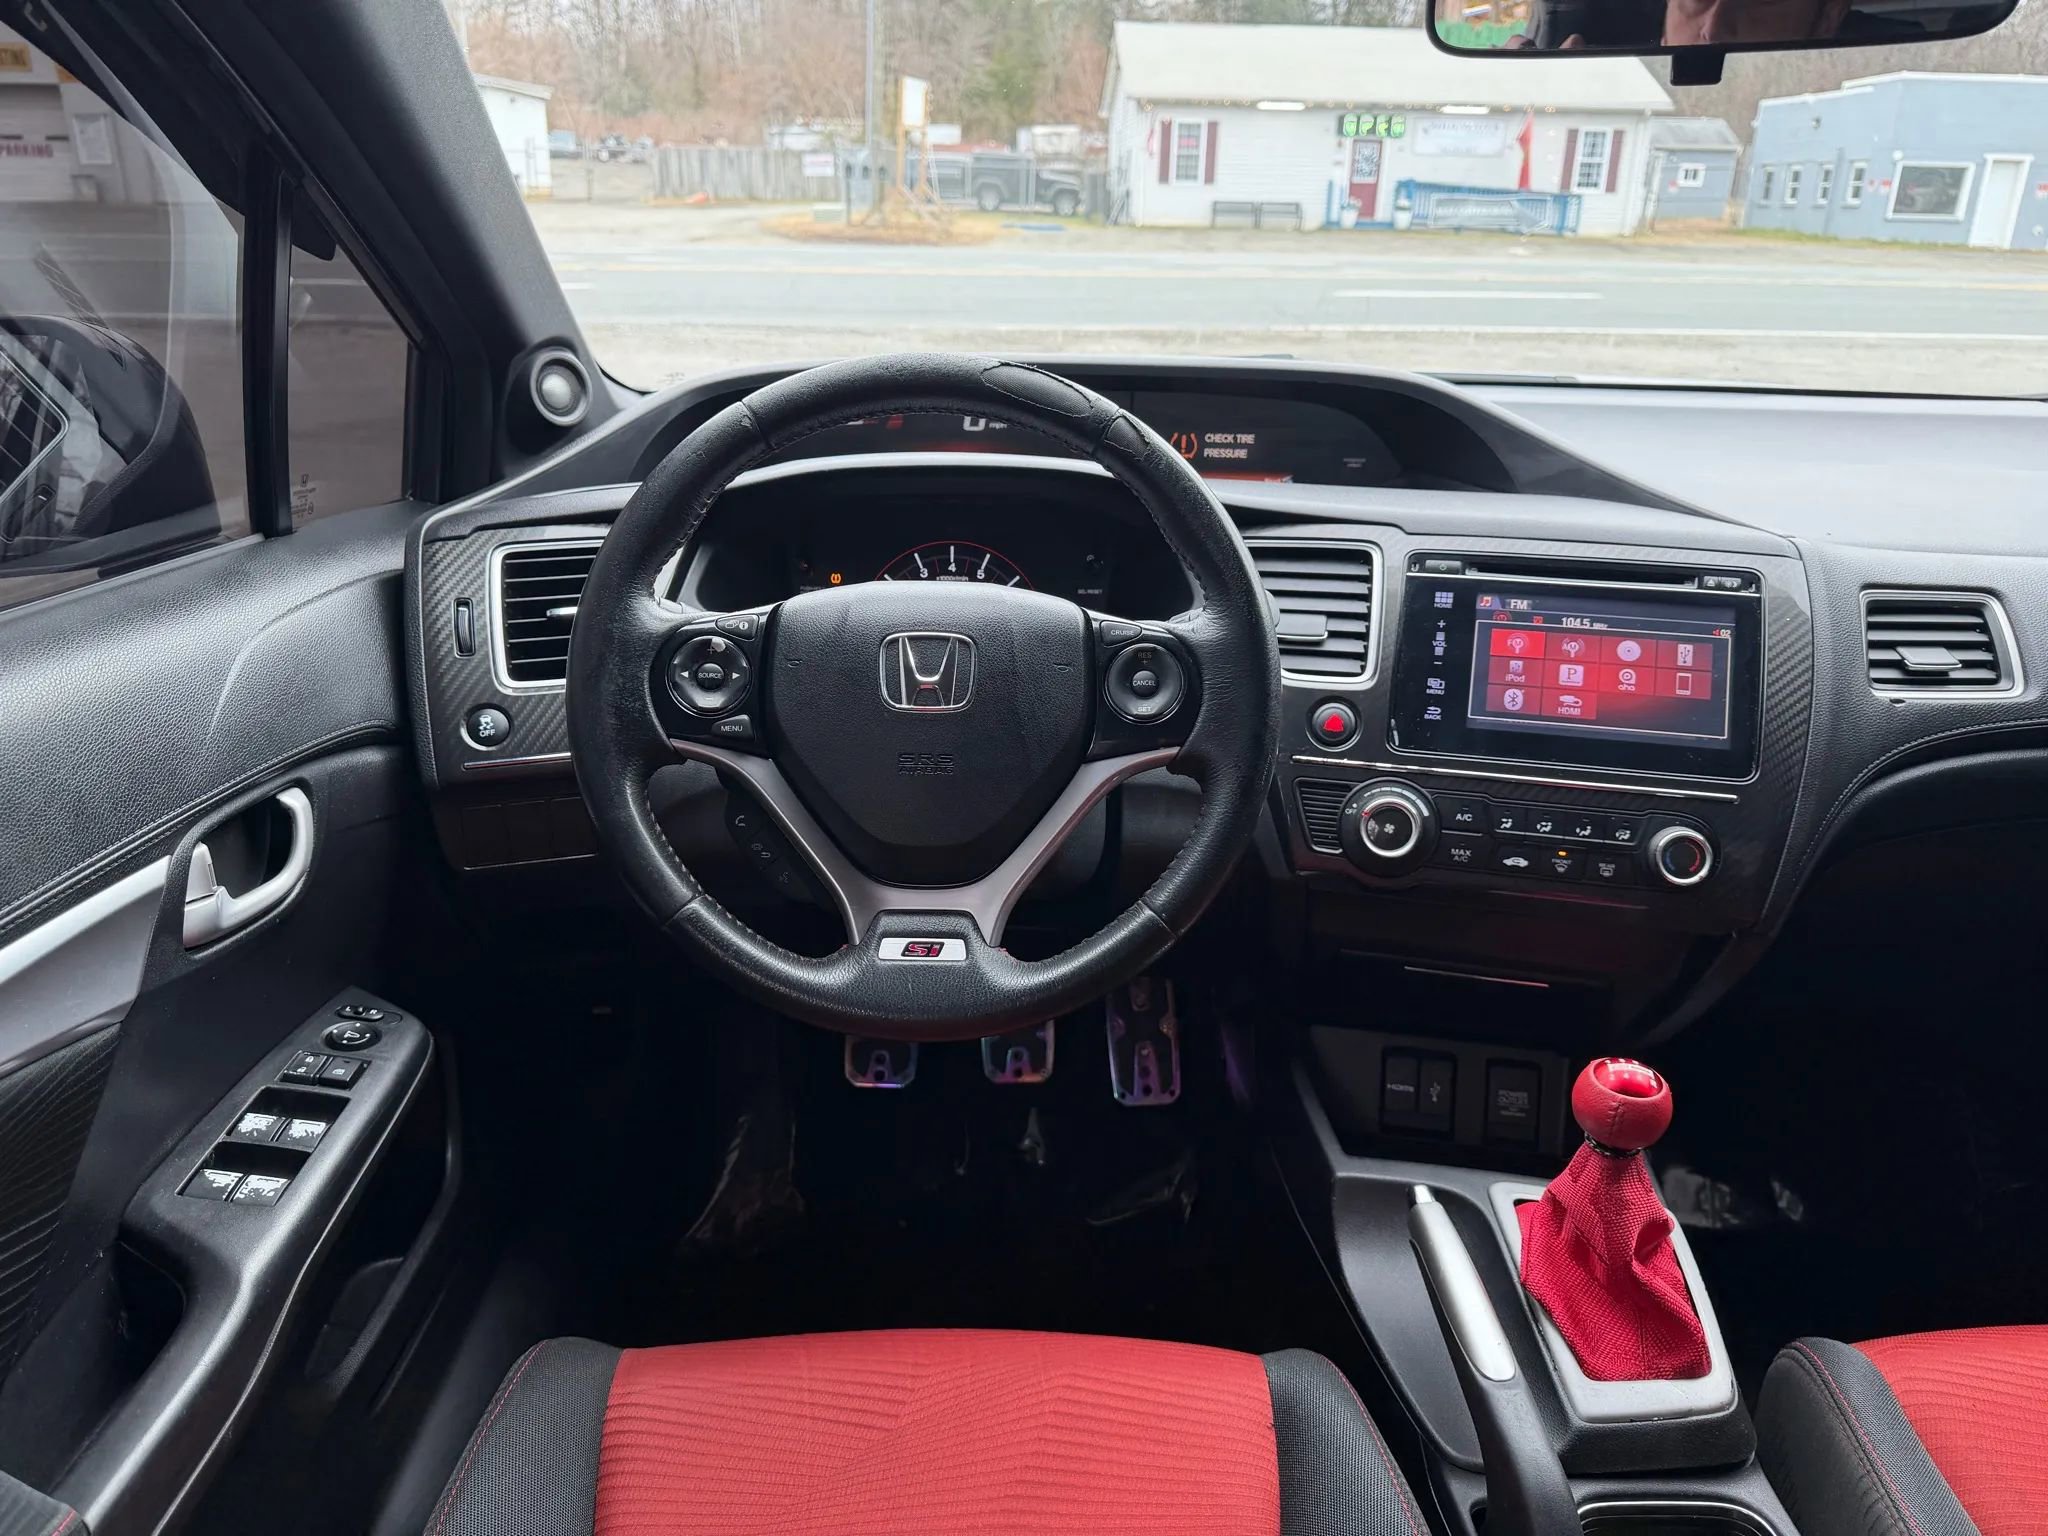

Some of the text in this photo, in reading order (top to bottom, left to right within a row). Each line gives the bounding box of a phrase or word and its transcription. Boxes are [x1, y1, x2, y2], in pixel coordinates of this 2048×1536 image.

[1204, 433, 1255, 445] CHECK TIRE
[1203, 448, 1249, 459] PRESSURE
[919, 567, 929, 578] 3
[948, 562, 957, 573] 4
[976, 569, 986, 580] 5
[1510, 598, 1528, 610] FM
[1719, 628, 1732, 638] 02
[1431, 640, 1447, 648] VOL
[1138, 651, 1152, 659] RES
[1132, 679, 1156, 687] CANCEL
[1505, 673, 1525, 683] iPod
[1426, 688, 1445, 696] MENU
[1557, 706, 1582, 716] HDMI
[1423, 713, 1442, 721] BACK
[479, 728, 496, 738] OFF
[898, 752, 955, 767] SRS
[1454, 813, 1473, 823] A/C
[1450, 848, 1472, 857] MAX
[1453, 855, 1470, 863] A/C
